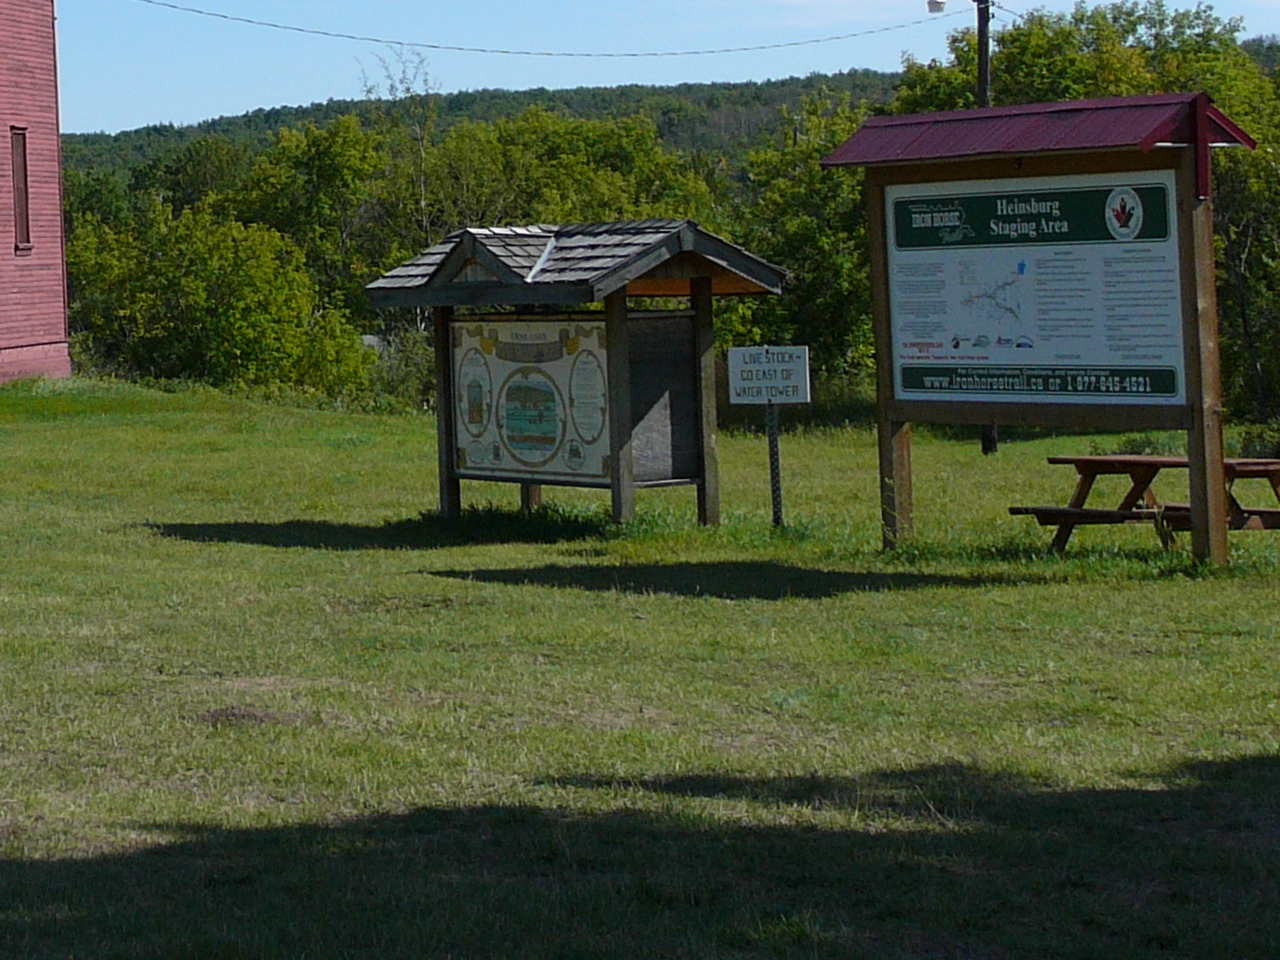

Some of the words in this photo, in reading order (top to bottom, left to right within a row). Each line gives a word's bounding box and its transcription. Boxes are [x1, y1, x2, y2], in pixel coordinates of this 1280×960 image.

[995, 197, 1061, 217] Heinsburg
[989, 217, 1037, 238] Staging
[1039, 217, 1069, 233] Area
[740, 370, 754, 382] GO
[756, 369, 778, 381] EAST
[781, 369, 795, 381] OF
[922, 374, 1044, 390] www.ironhorsetrail.ca
[1048, 378, 1062, 390] or
[734, 386, 763, 398] WATER
[765, 385, 800, 398] TOWER
